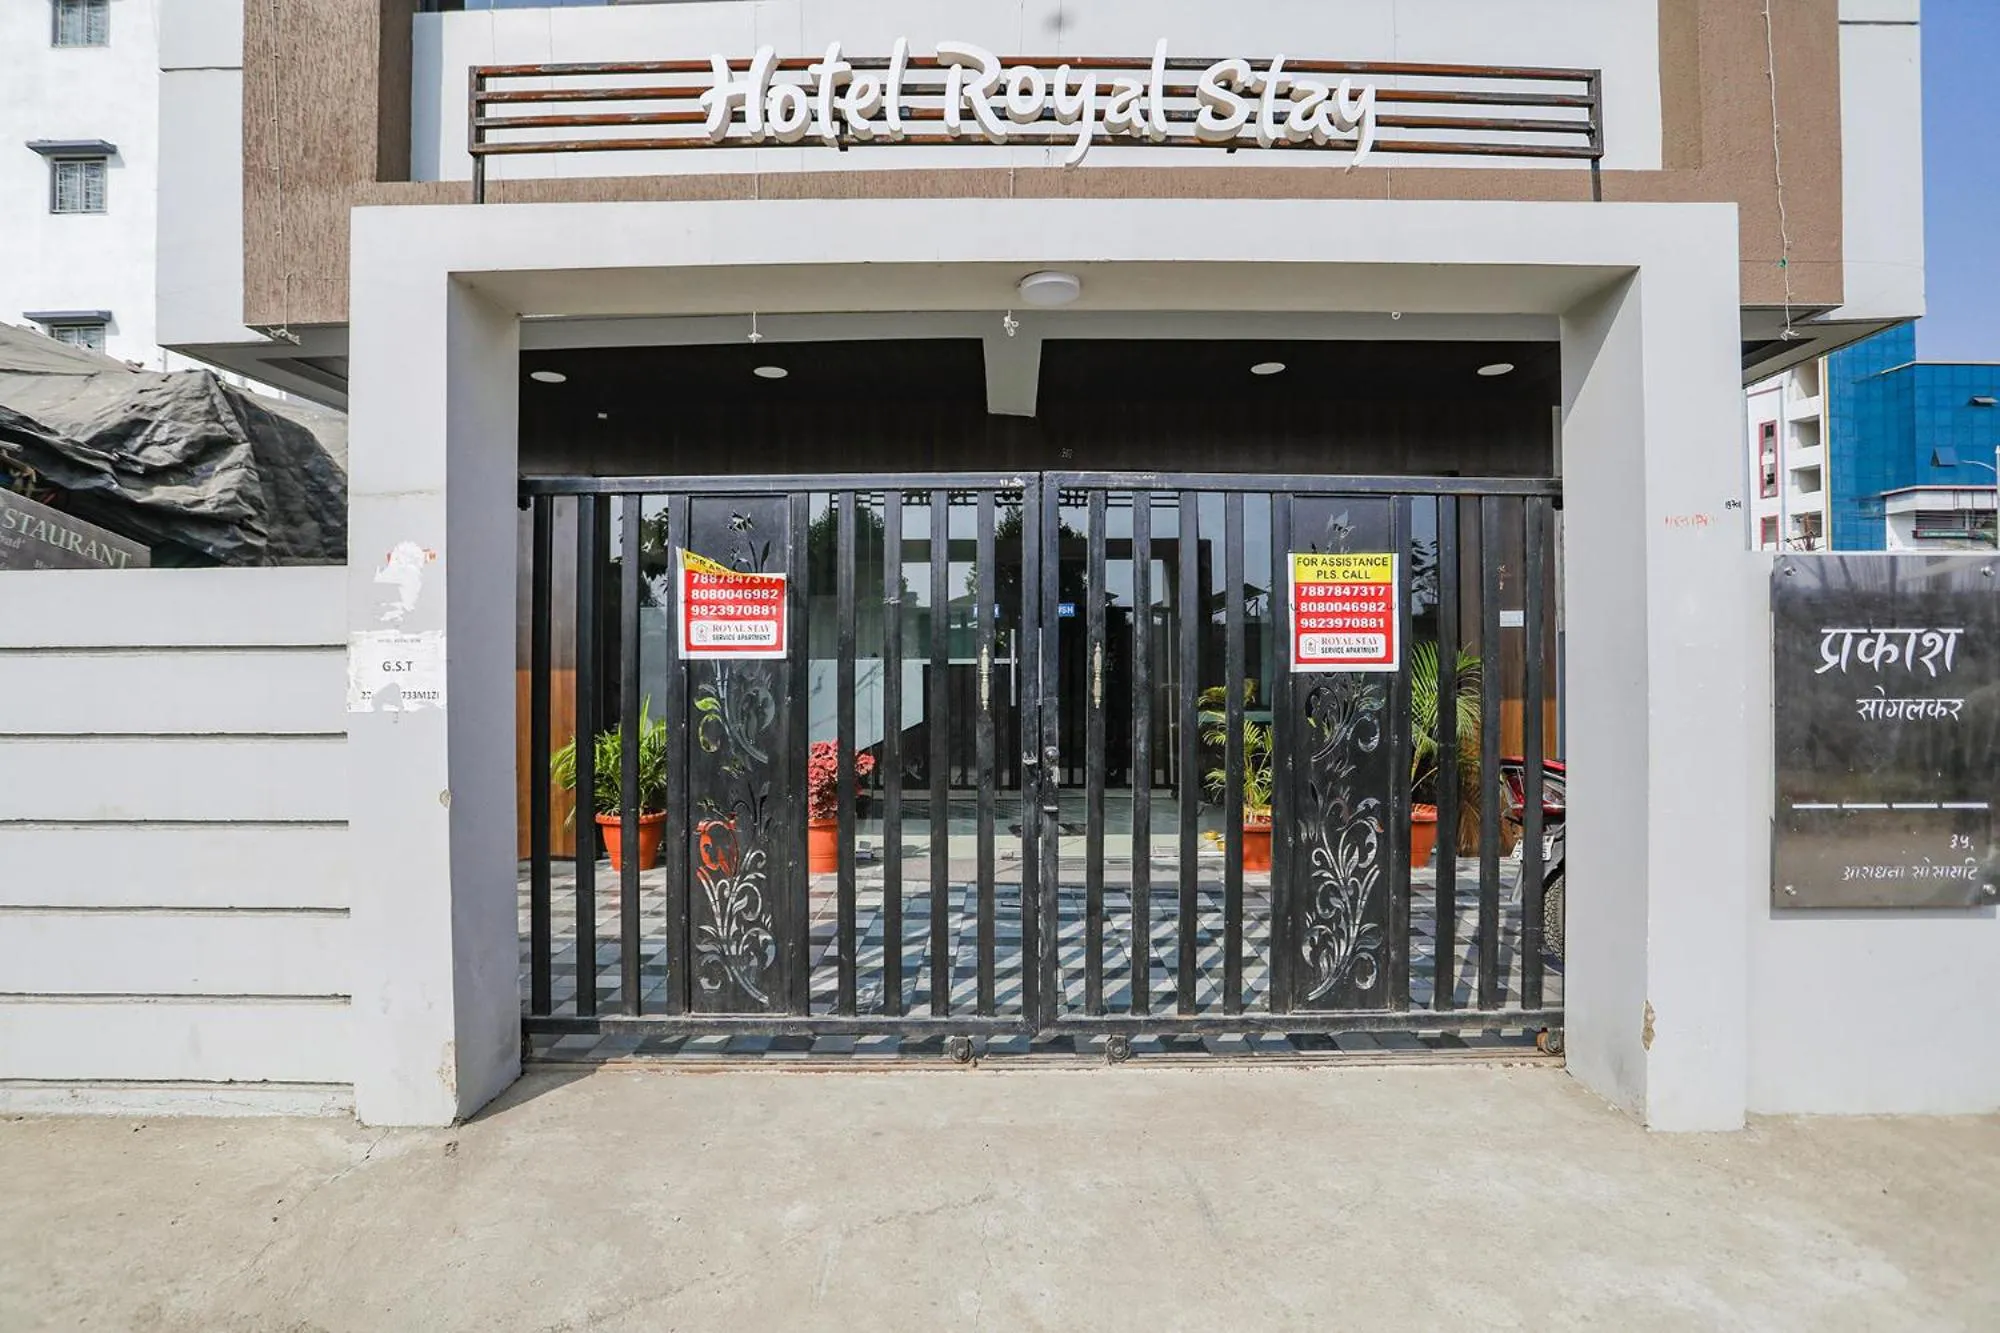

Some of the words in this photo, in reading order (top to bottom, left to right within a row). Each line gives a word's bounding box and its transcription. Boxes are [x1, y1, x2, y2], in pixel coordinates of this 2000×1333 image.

[700, 36, 910, 148] Hotel
[936, 38, 1168, 169] Royal
[1194, 53, 1376, 173] Stay
[1297, 557, 1318, 567] FOR
[1321, 556, 1389, 567] ASSISTANCE
[1317, 570, 1340, 580] PLS.
[1342, 570, 1371, 580] CALL
[691, 589, 779, 600] 8080046982
[1301, 586, 1385, 597] 7887847317
[691, 605, 777, 616] 9823970881
[1300, 602, 1387, 612] 8080046982
[712, 624, 746, 632] ROYAL
[748, 624, 770, 632] STAY
[1300, 618, 1385, 629] 9823970881
[1321, 637, 1354, 645] ROYAL
[1356, 637, 1378, 645] STAY
[1814, 627, 1964, 678] प्रकाश
[382, 660, 413, 672] G.S.T
